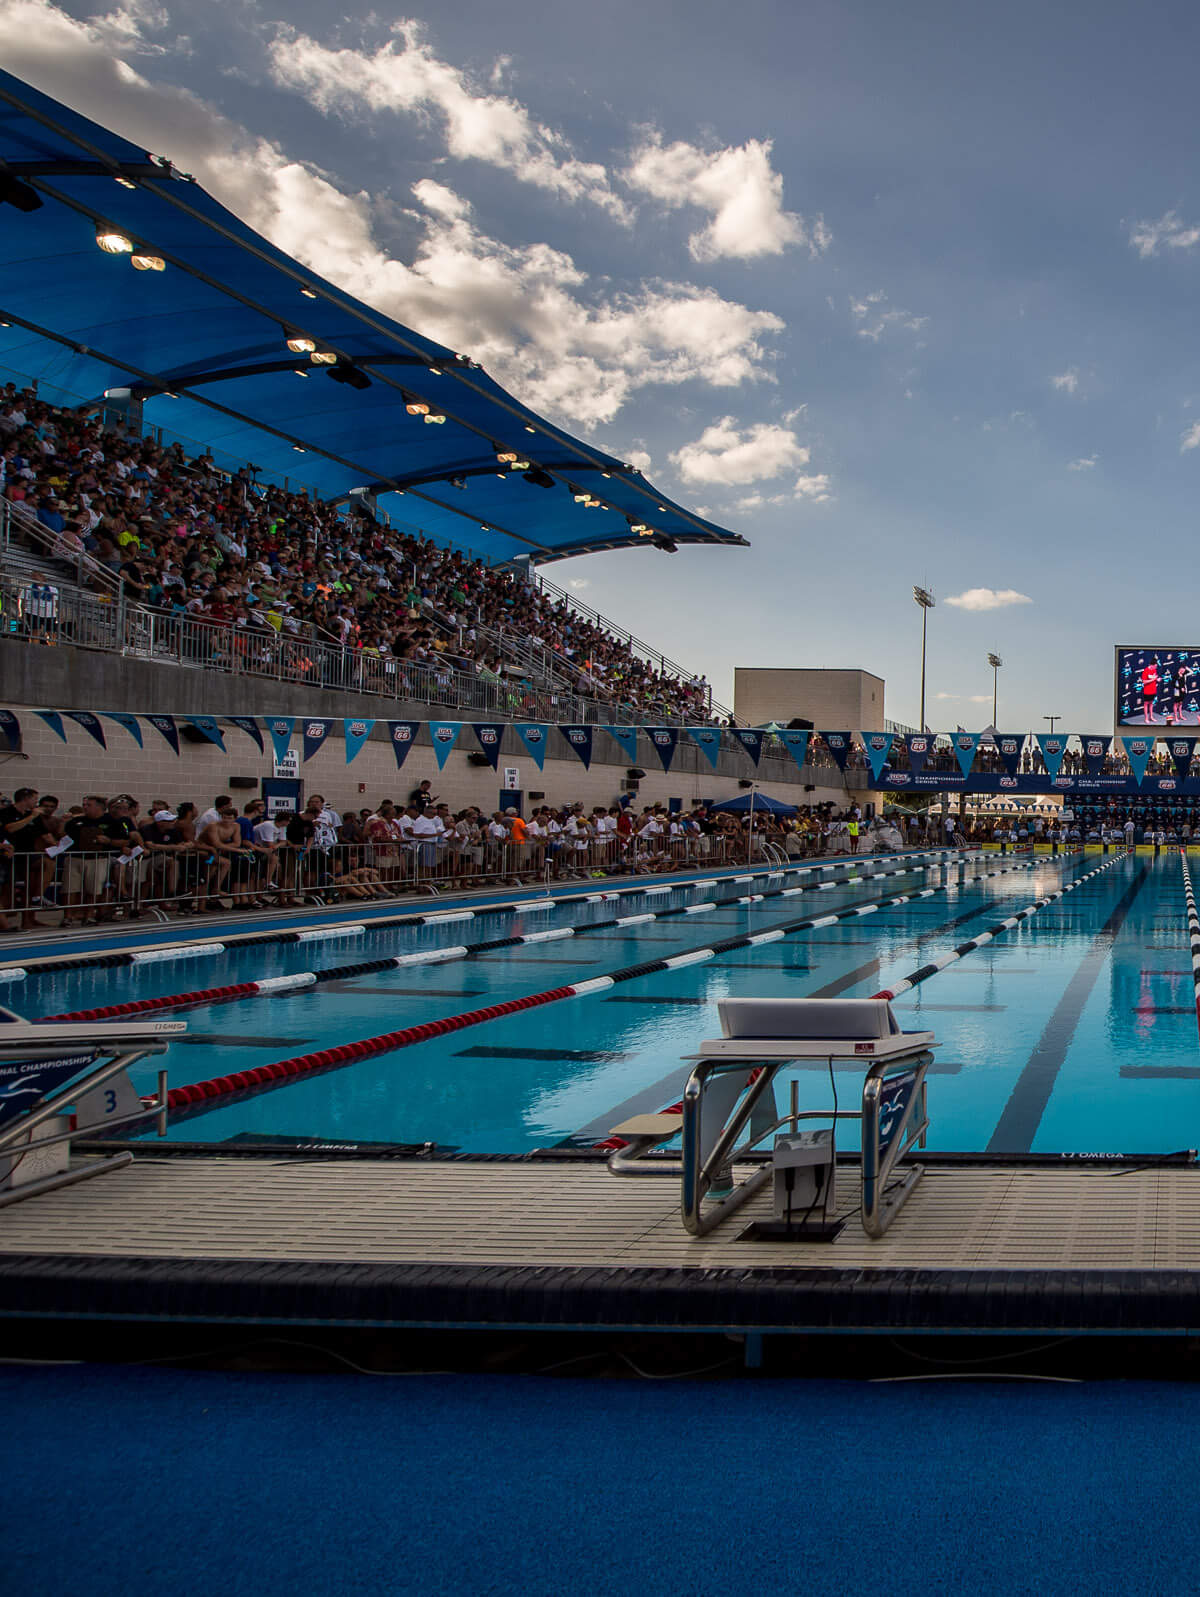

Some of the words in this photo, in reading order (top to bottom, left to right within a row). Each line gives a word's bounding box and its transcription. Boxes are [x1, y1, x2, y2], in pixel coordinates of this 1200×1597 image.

[275, 759, 297, 767] LCKER
[20, 1055, 93, 1074] CHAMPIONSHIPS
[104, 1089, 117, 1113] 3
